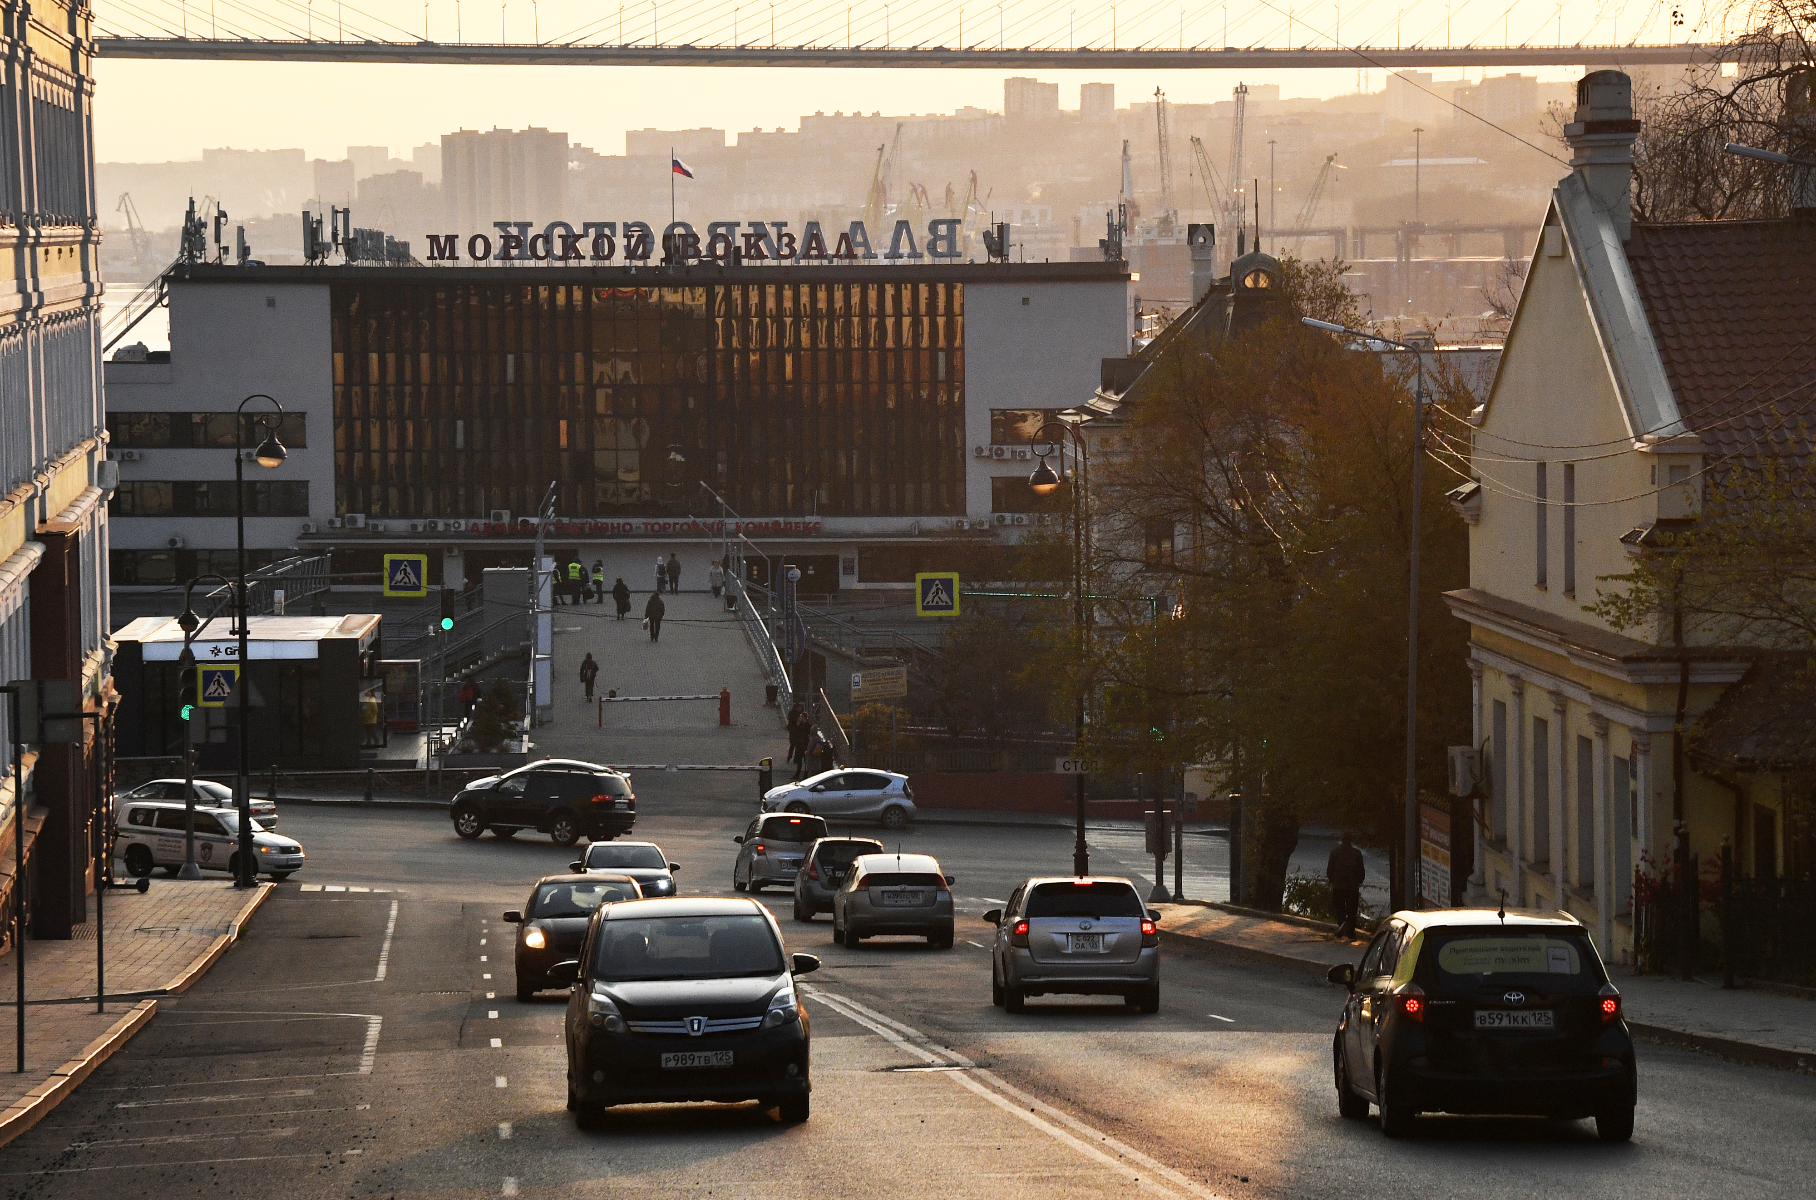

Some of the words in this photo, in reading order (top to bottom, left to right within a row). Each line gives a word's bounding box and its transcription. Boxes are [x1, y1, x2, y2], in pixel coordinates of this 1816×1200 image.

[426, 229, 651, 261] МОРСКОЙ
[678, 232, 858, 261] ВОКЗАЛ
[1494, 955, 1530, 965] mxim
